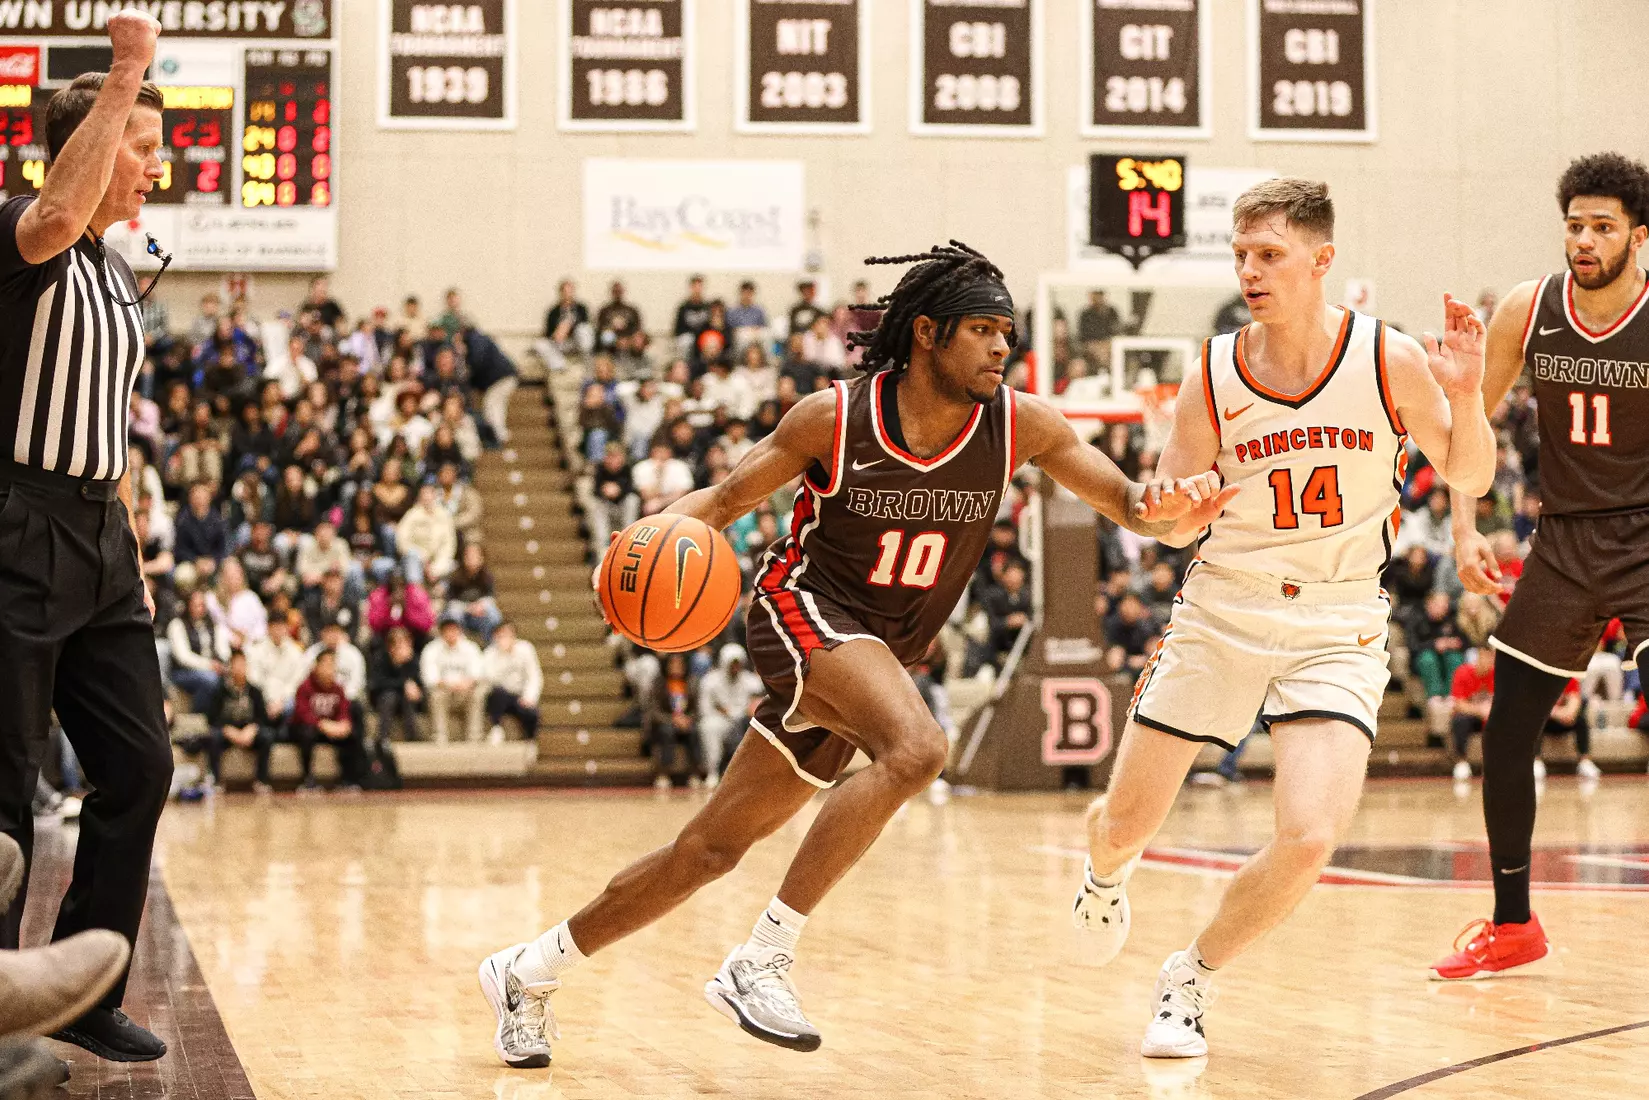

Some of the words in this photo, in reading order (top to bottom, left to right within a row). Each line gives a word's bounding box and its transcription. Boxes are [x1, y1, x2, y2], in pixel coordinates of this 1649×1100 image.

[411, 5, 485, 33] NCAA
[590, 8, 663, 36] NCAA
[776, 18, 831, 55] NIT
[948, 21, 1006, 58] CBI
[1119, 24, 1173, 61] CIT
[1283, 28, 1340, 65] CBI
[407, 66, 489, 103] 1939
[760, 72, 848, 108] 2003
[934, 74, 1021, 111] 2008
[1105, 76, 1187, 113] 2014
[1272, 80, 1352, 116] 2019
[22, 160, 45, 189] 4
[1128, 191, 1171, 237] 14
[1534, 353, 1649, 388] BROWN
[1568, 390, 1612, 446] 11
[1235, 425, 1374, 463] PRINCETON
[847, 487, 995, 522] BROWN
[1268, 465, 1343, 530] 14
[620, 525, 659, 593] ELITE
[867, 529, 949, 591] 10
[1041, 678, 1113, 765] B
